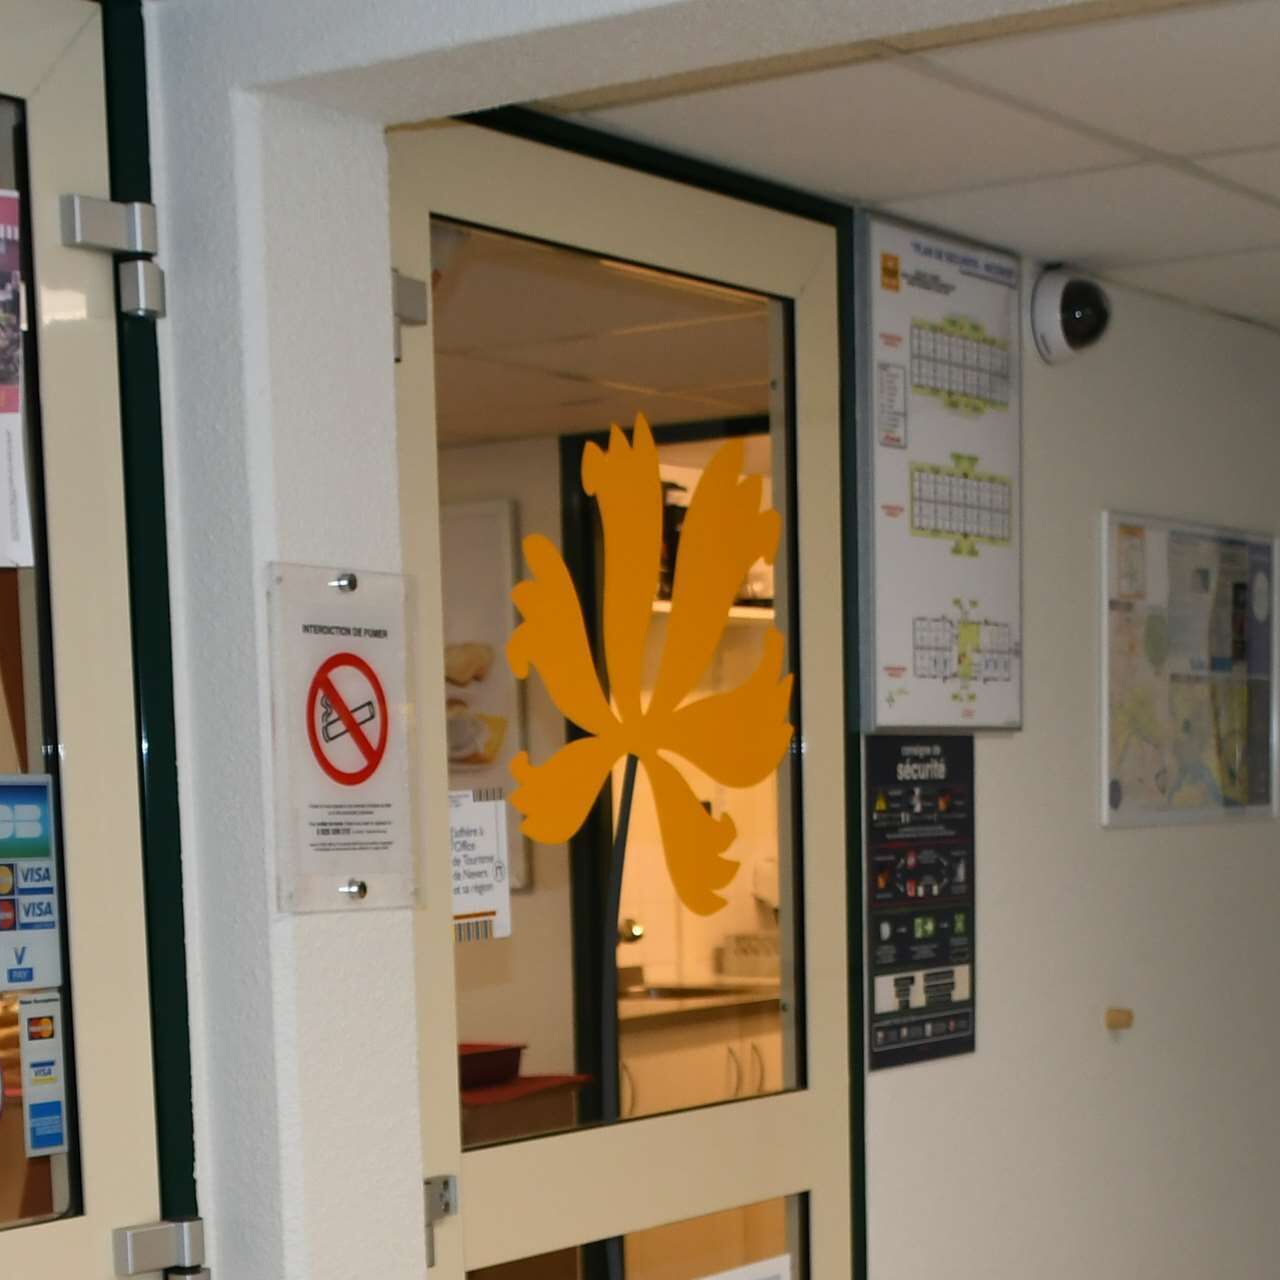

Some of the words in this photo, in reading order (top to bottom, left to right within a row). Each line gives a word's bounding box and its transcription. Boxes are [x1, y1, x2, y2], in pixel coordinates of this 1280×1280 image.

[302, 624, 351, 636] INTERDICTION
[352, 627, 362, 637] DE
[896, 758, 946, 781] sécurité
[20, 866, 51, 882] VISA
[22, 902, 53, 917] VISA
